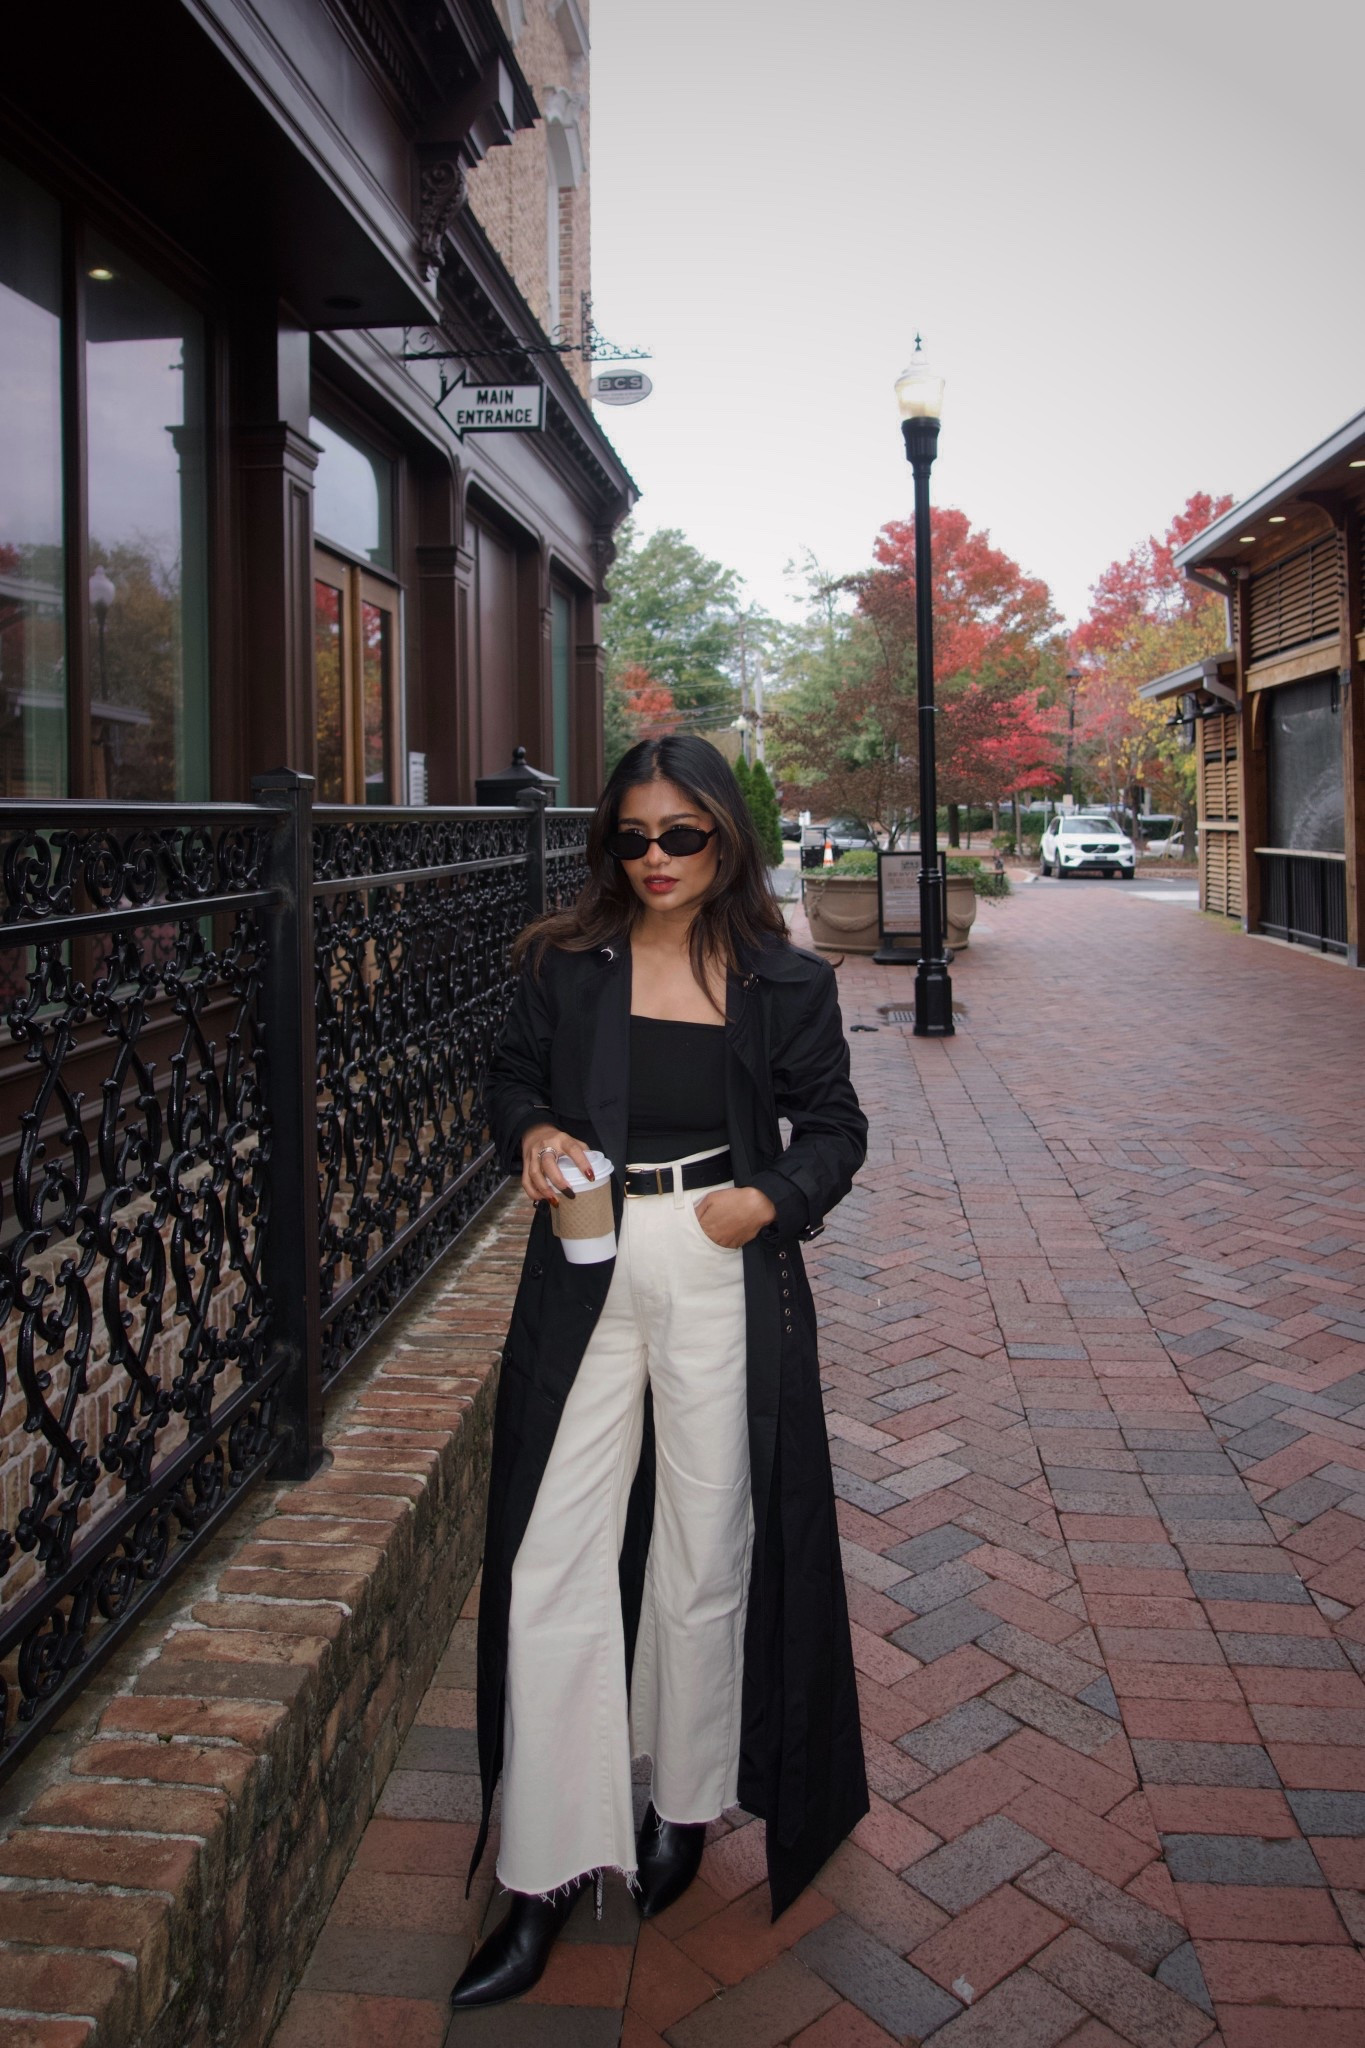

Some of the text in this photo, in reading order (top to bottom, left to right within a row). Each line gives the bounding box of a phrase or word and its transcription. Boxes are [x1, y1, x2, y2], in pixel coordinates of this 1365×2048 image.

[599, 377, 641, 390] BCS
[477, 389, 514, 405] MAIN
[456, 408, 533, 425] ENTRANCE
